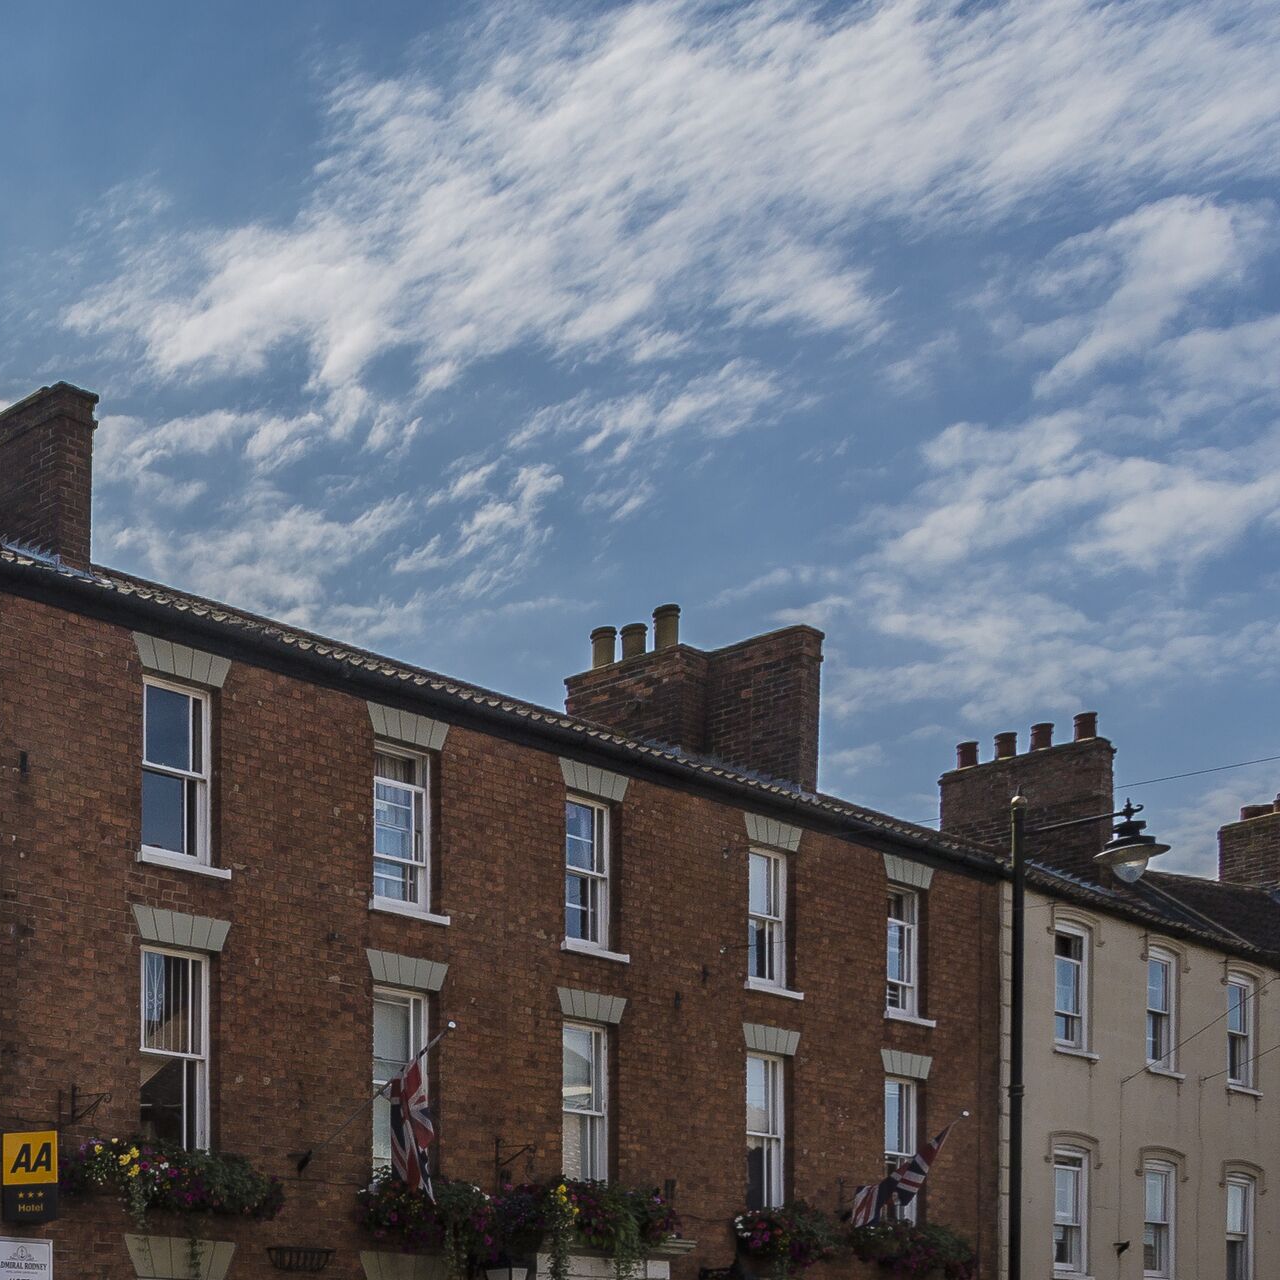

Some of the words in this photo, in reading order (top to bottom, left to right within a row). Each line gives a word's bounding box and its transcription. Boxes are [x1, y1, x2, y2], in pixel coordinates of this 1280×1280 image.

[10, 1142, 52, 1174] AA
[18, 1203, 44, 1213] Hotel
[24, 1262, 48, 1271] RODNEY
